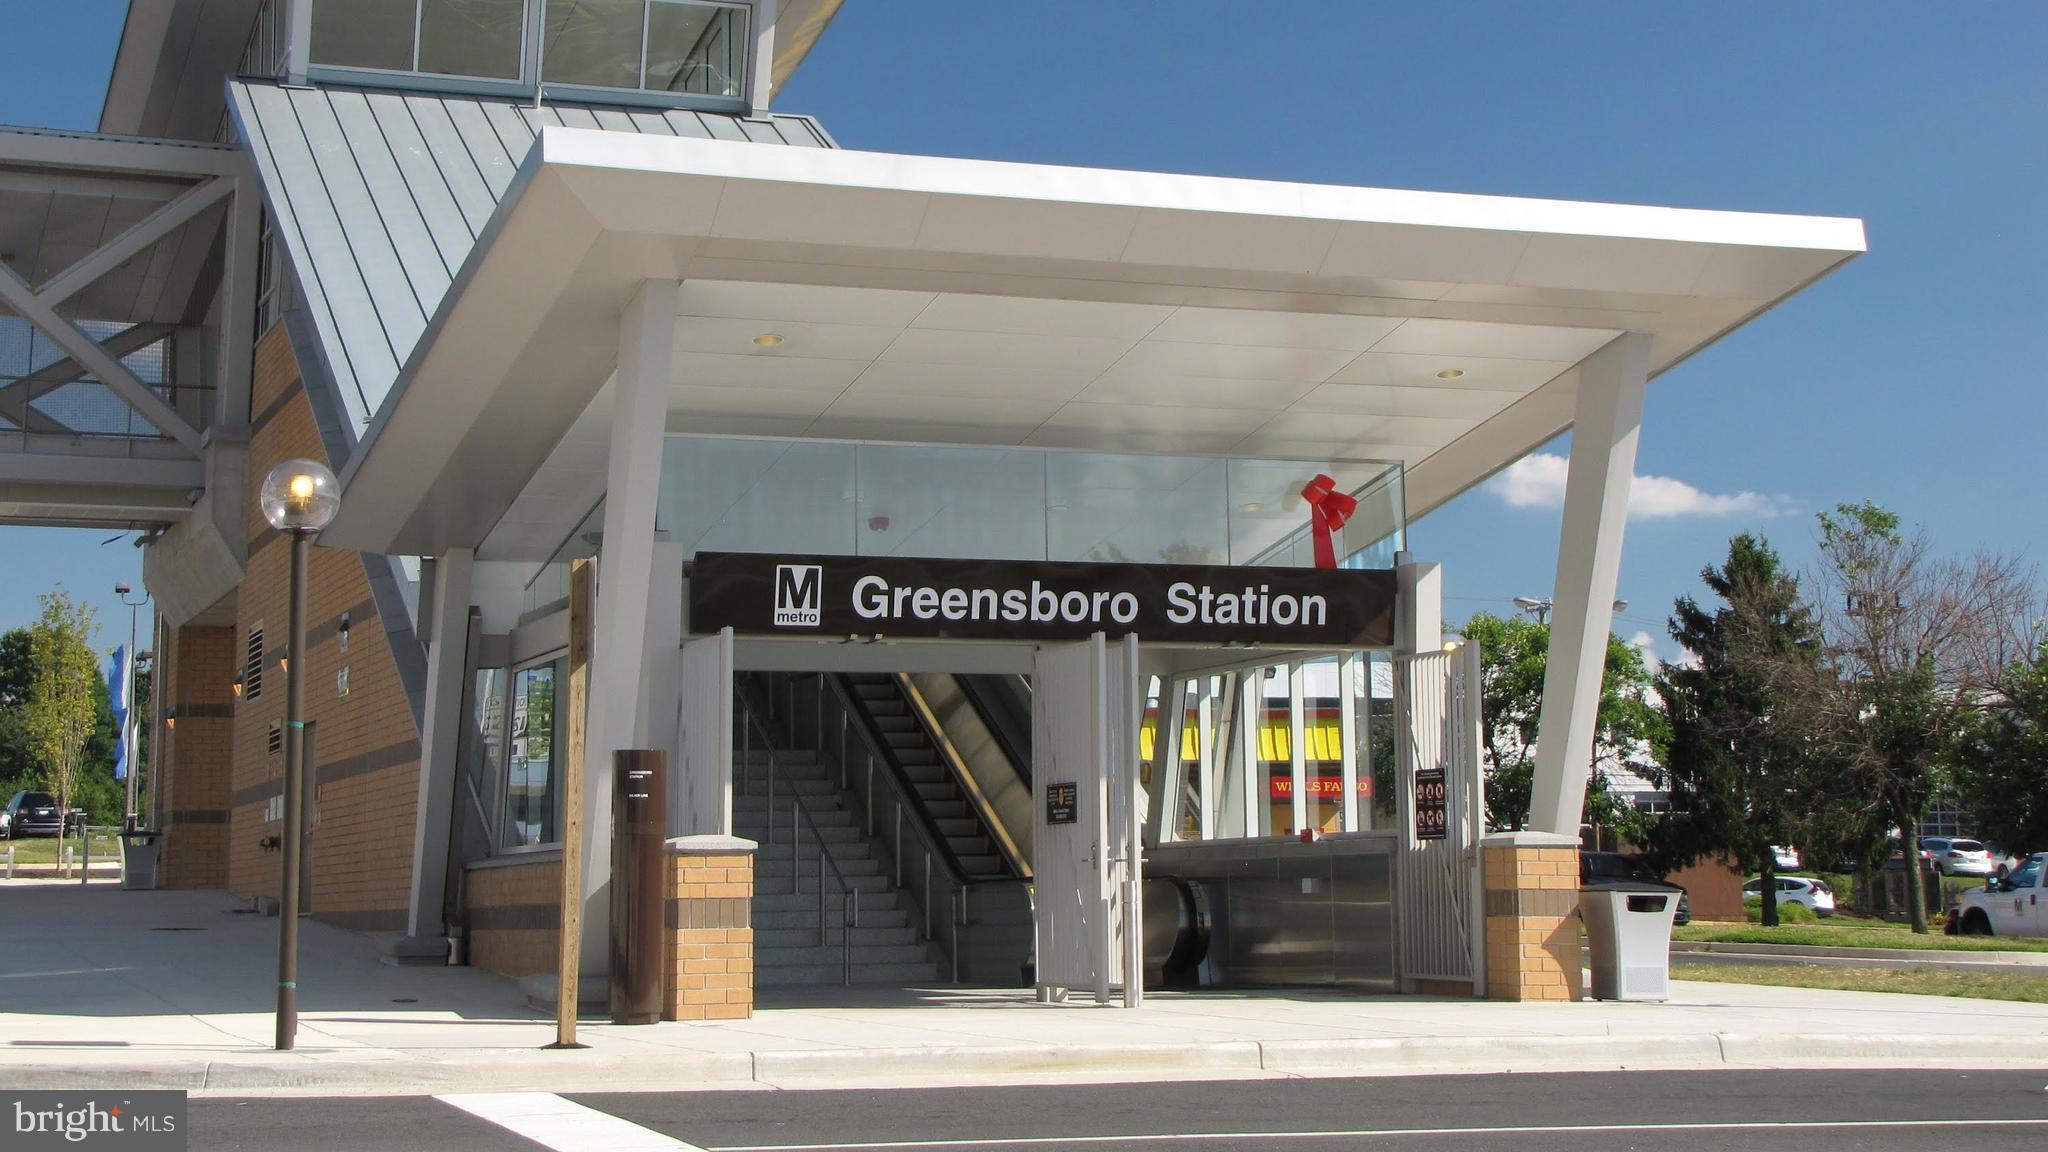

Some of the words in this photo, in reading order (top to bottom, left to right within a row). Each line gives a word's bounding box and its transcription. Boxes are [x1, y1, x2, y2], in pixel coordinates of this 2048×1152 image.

[778, 568, 819, 609] M
[852, 575, 1139, 624] Greensboro
[1166, 581, 1326, 626] Station
[777, 611, 817, 623] metro
[1275, 781, 1321, 792] WLS
[1323, 781, 1368, 792] FAO
